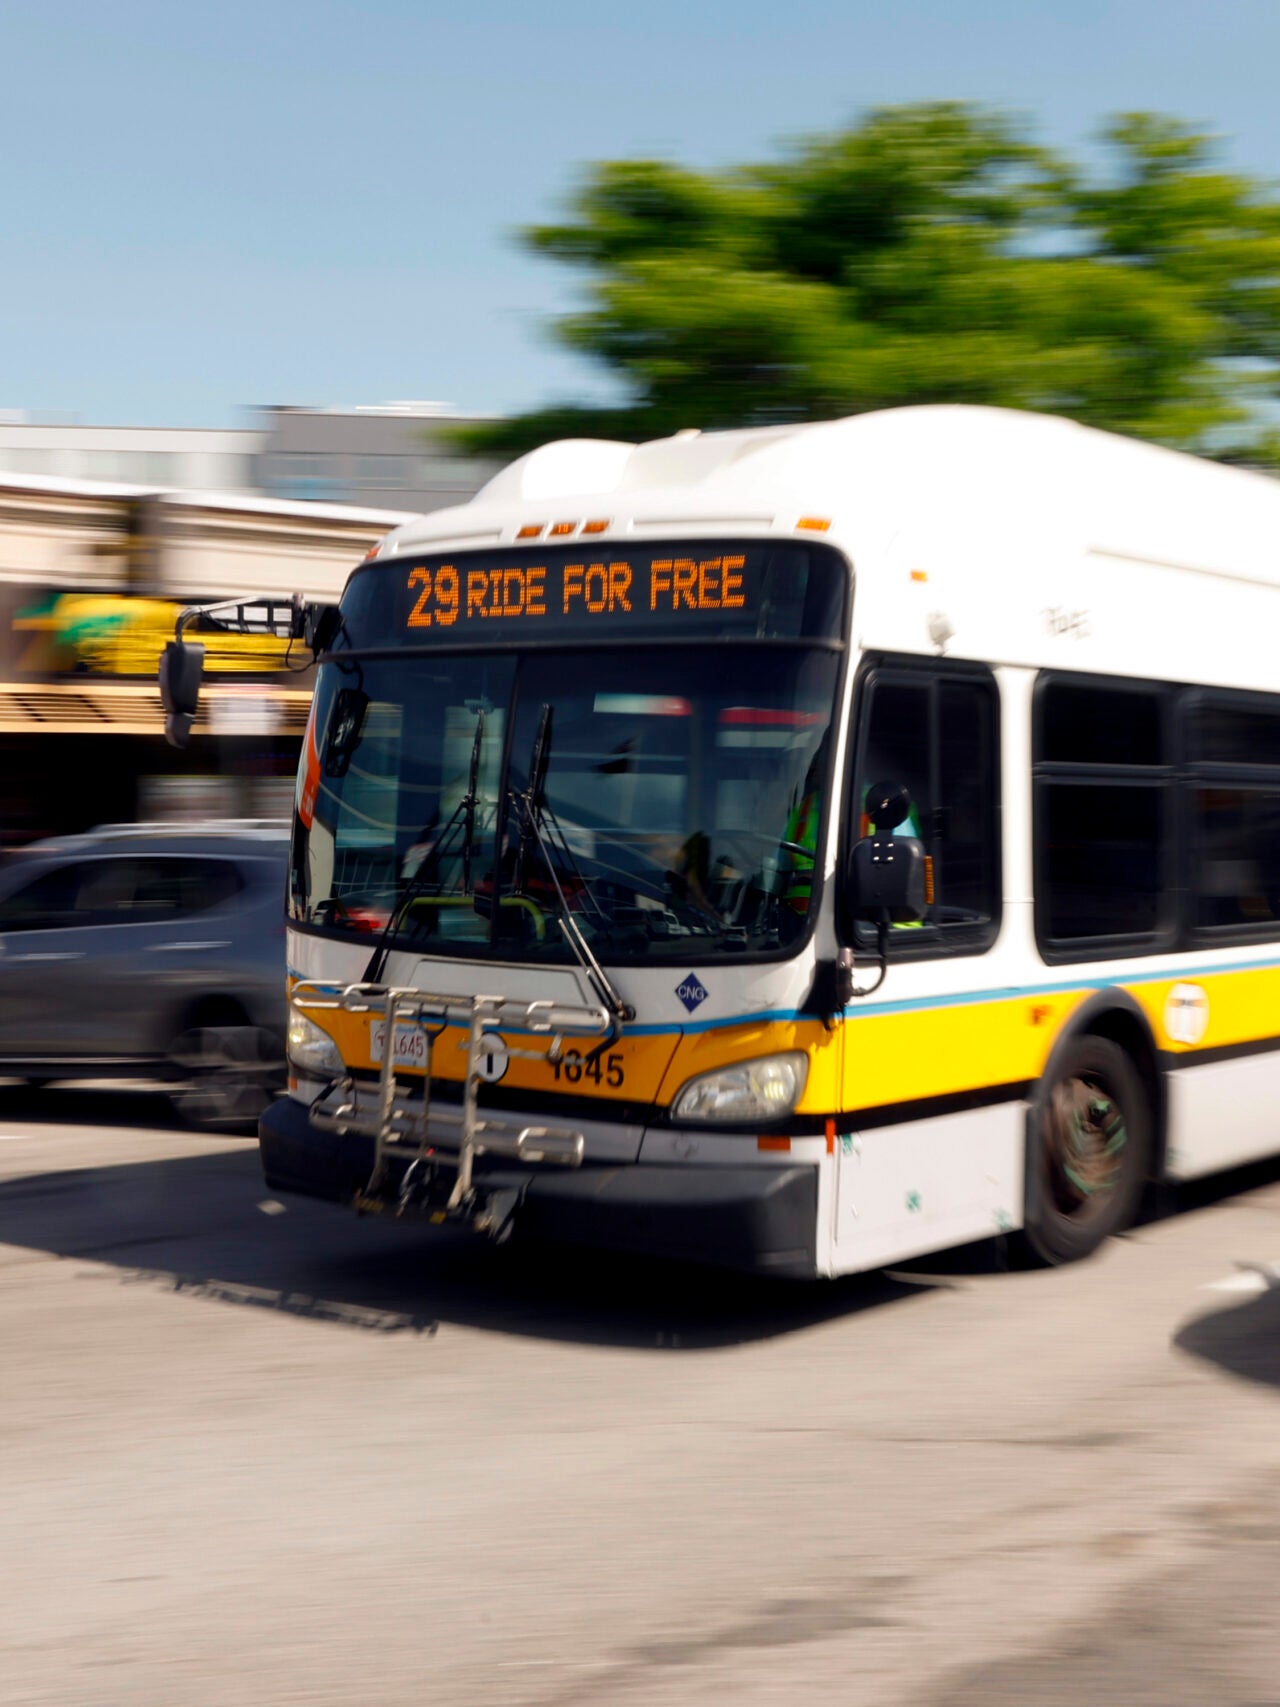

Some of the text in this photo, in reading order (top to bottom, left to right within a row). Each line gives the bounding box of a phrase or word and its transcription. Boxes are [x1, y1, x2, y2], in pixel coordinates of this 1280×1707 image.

[407, 555, 746, 627] 29 RIDE FOR FREE
[677, 985, 705, 1001] CNG
